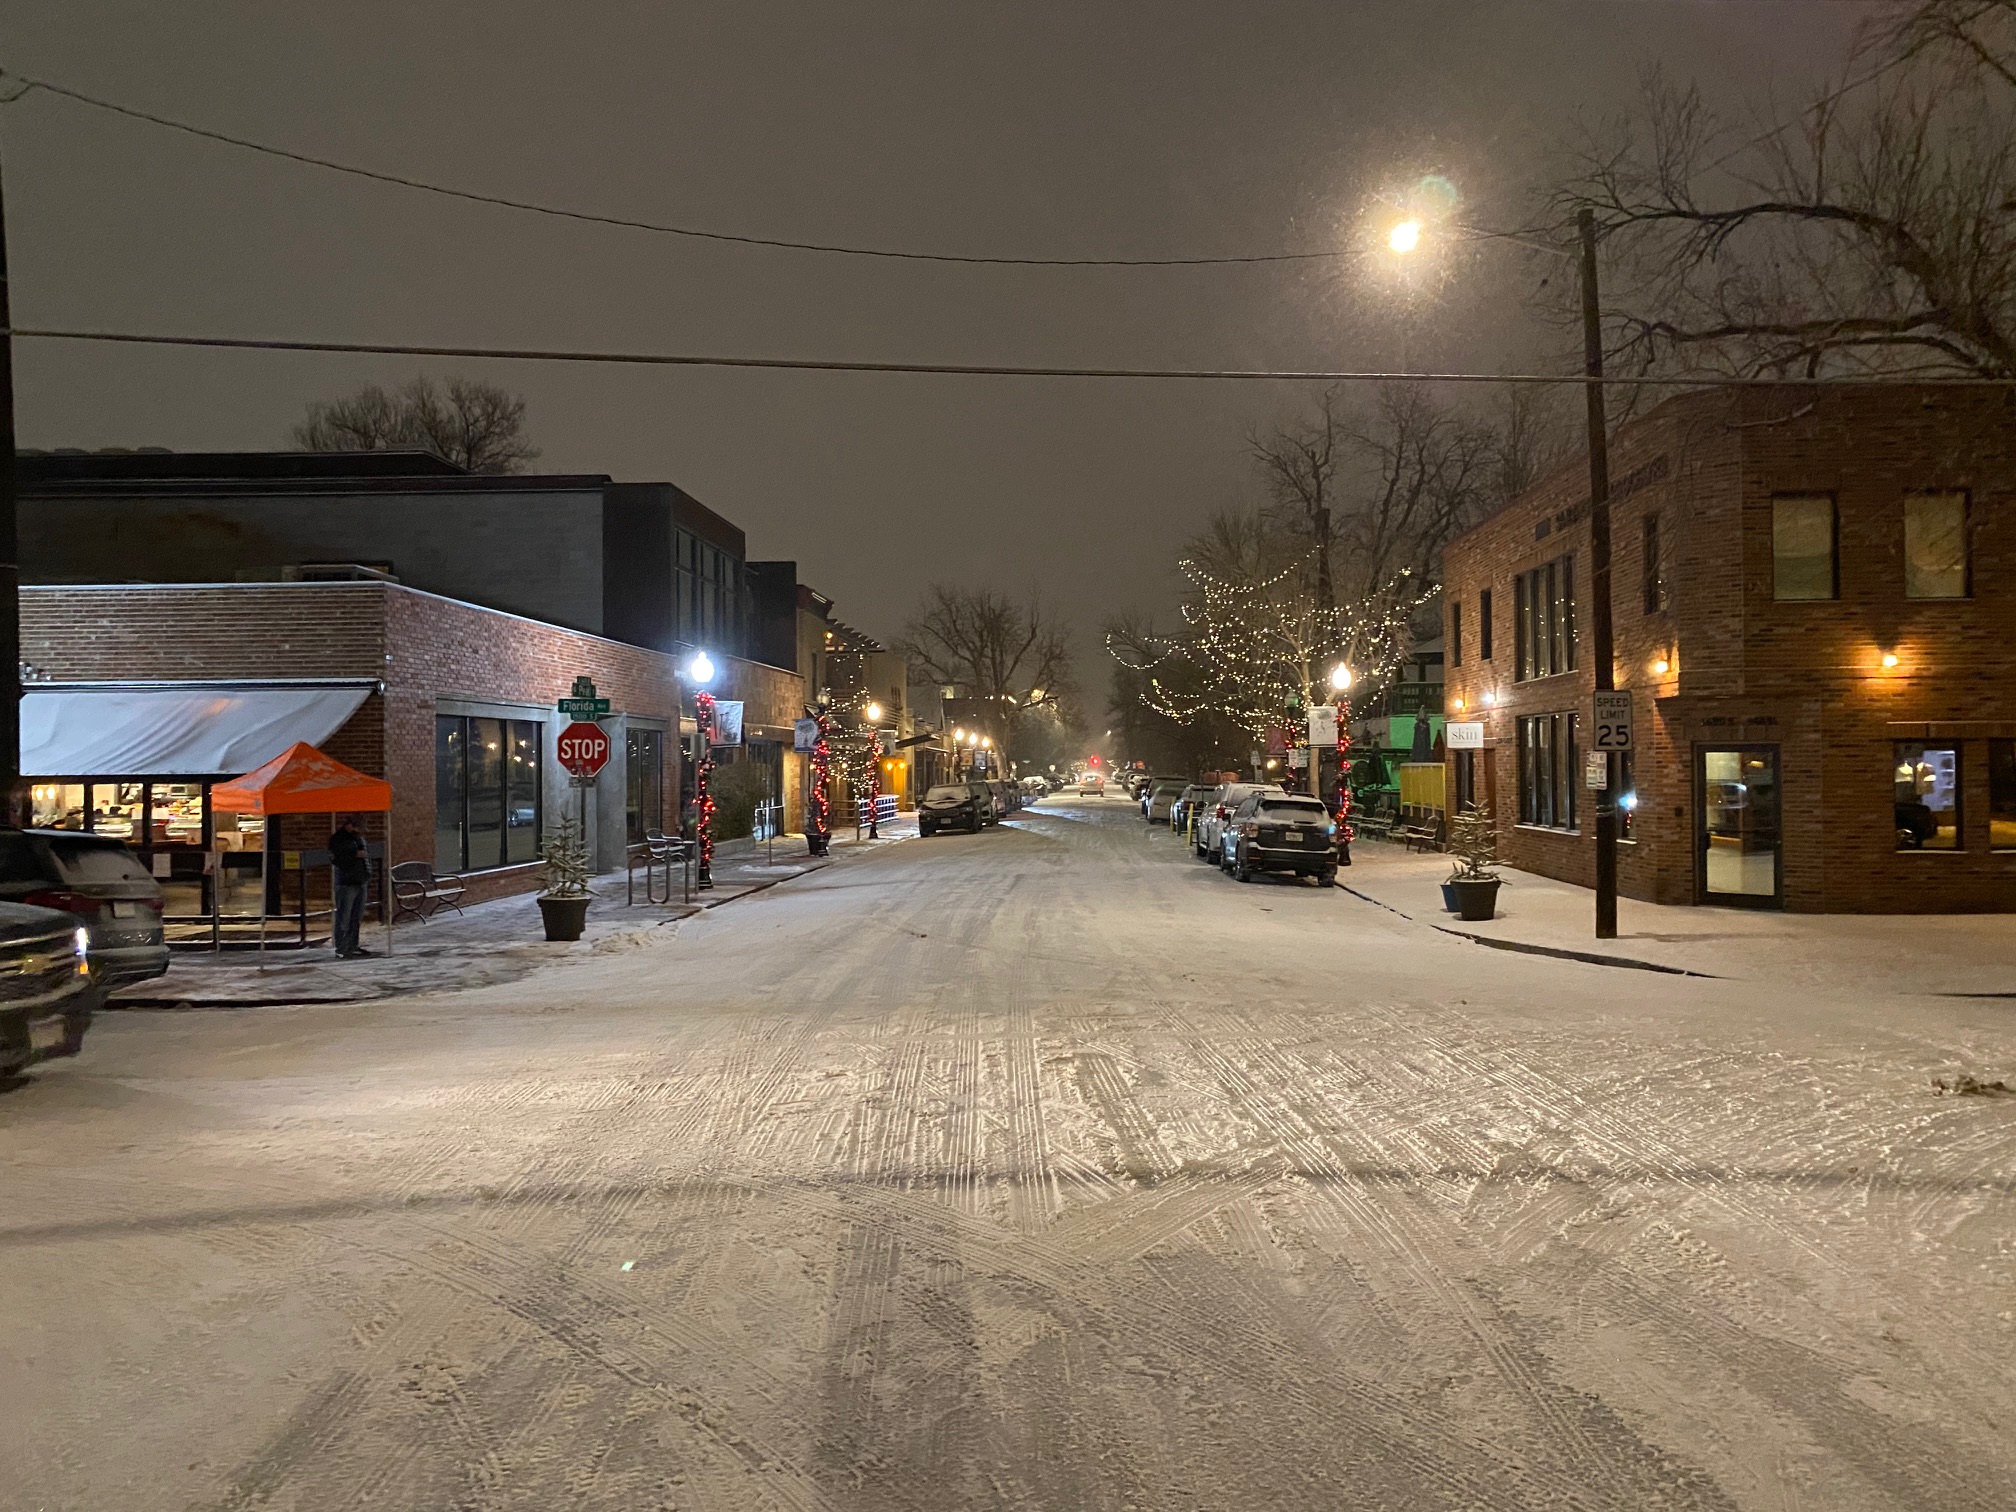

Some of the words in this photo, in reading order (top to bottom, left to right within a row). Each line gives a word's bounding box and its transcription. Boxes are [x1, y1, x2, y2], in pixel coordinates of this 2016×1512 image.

[563, 700, 595, 712] Florida
[1597, 697, 1629, 707] SPEED
[1601, 710, 1625, 720] LIMIT
[1451, 727, 1478, 741] skin
[1598, 724, 1630, 747] 25
[560, 738, 606, 760] STOP
